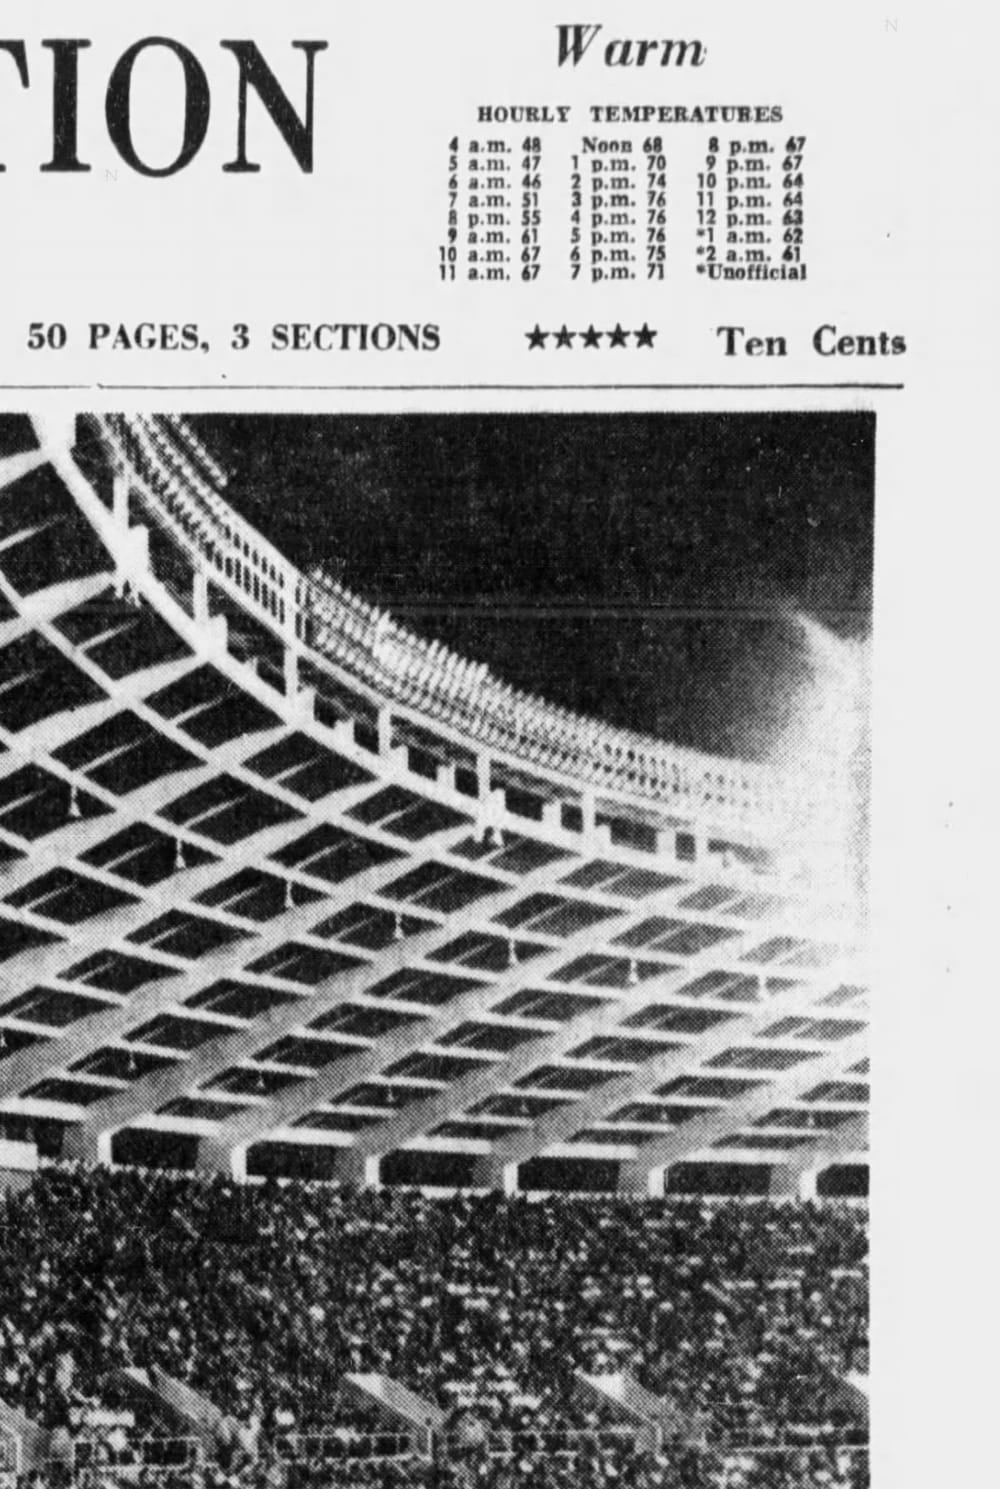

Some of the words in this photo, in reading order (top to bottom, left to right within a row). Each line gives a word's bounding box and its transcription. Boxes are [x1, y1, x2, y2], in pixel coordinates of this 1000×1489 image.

[555, 23, 707, 68] Warm
[477, 105, 571, 123] HOURLY
[589, 105, 784, 124] TEMPERATURES
[582, 136, 632, 153] Noon
[642, 136, 663, 153] 68
[570, 154, 581, 171] 1
[591, 158, 636, 174] p.m.
[647, 154, 667, 171] 70
[570, 172, 581, 189] 2
[591, 176, 636, 192] p.m.
[647, 172, 667, 189] 74
[570, 190, 581, 207] 3
[591, 194, 636, 210] p.m.
[647, 190, 667, 207] 76
[570, 208, 581, 225] 4
[591, 212, 636, 228] p.m.
[647, 208, 667, 225] 76
[570, 226, 581, 243] 5
[591, 230, 636, 246] p.m.
[647, 226, 667, 243] 76
[570, 244, 581, 261] 6
[591, 248, 636, 264] p.m.
[647, 244, 667, 261] 75
[570, 262, 581, 279] 7
[591, 266, 636, 282] p.m.
[647, 262, 667, 279] 71
[27, 322, 67, 350] 50
[89, 322, 210, 353] PAGES,
[231, 323, 250, 350] 3
[271, 322, 441, 351] SECTIONS
[716, 326, 788, 357] Ten
[812, 324, 907, 357] Cents
